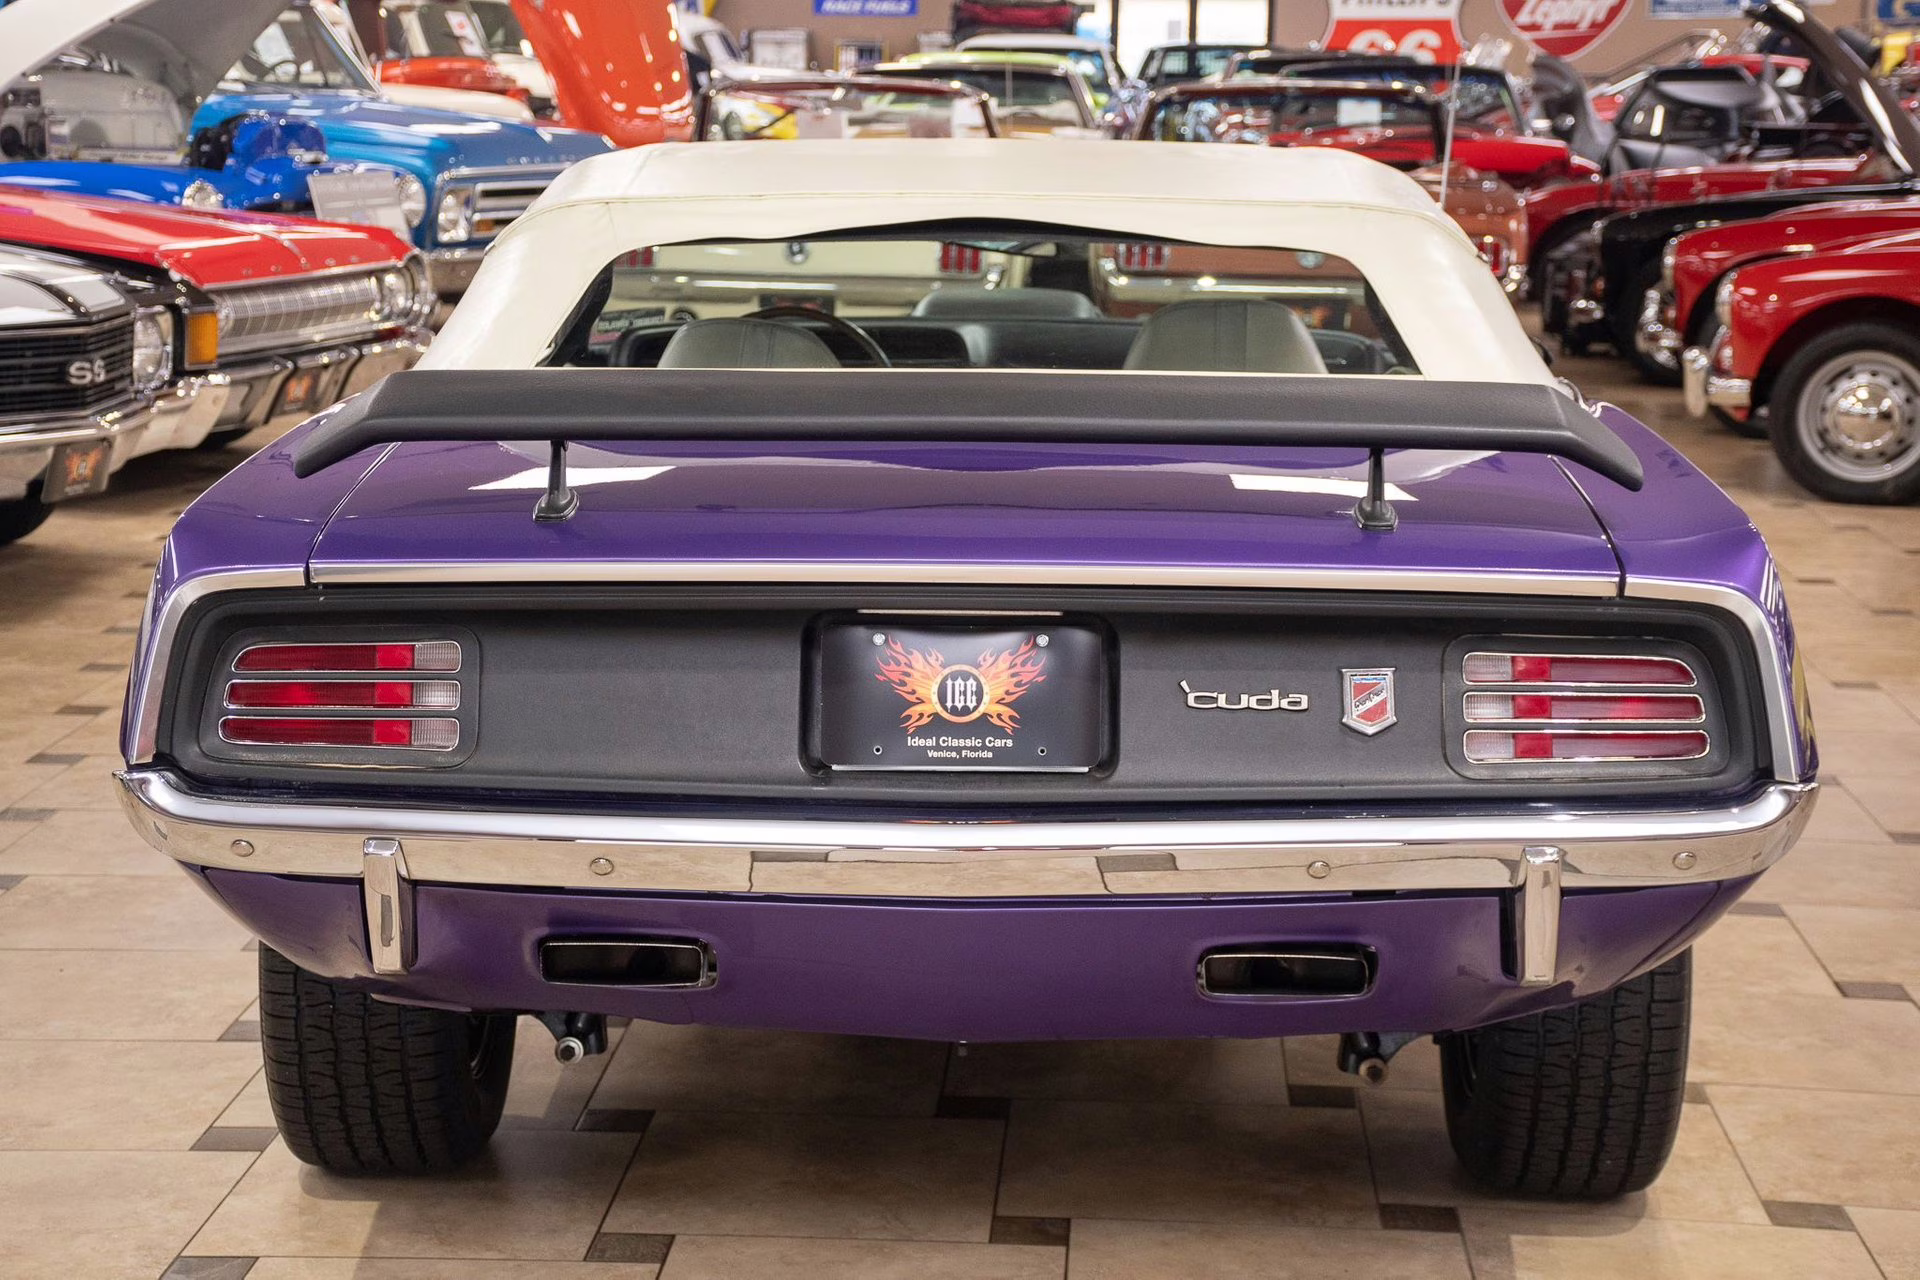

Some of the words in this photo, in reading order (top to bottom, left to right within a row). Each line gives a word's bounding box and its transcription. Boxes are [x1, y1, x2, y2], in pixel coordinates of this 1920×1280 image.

[68, 359, 105, 385] SS
[907, 736, 936, 747] Ideal
[939, 736, 982, 747] Classic
[985, 736, 1013, 748] Cars
[927, 749, 960, 759] Venice,
[961, 750, 993, 759] Florida
